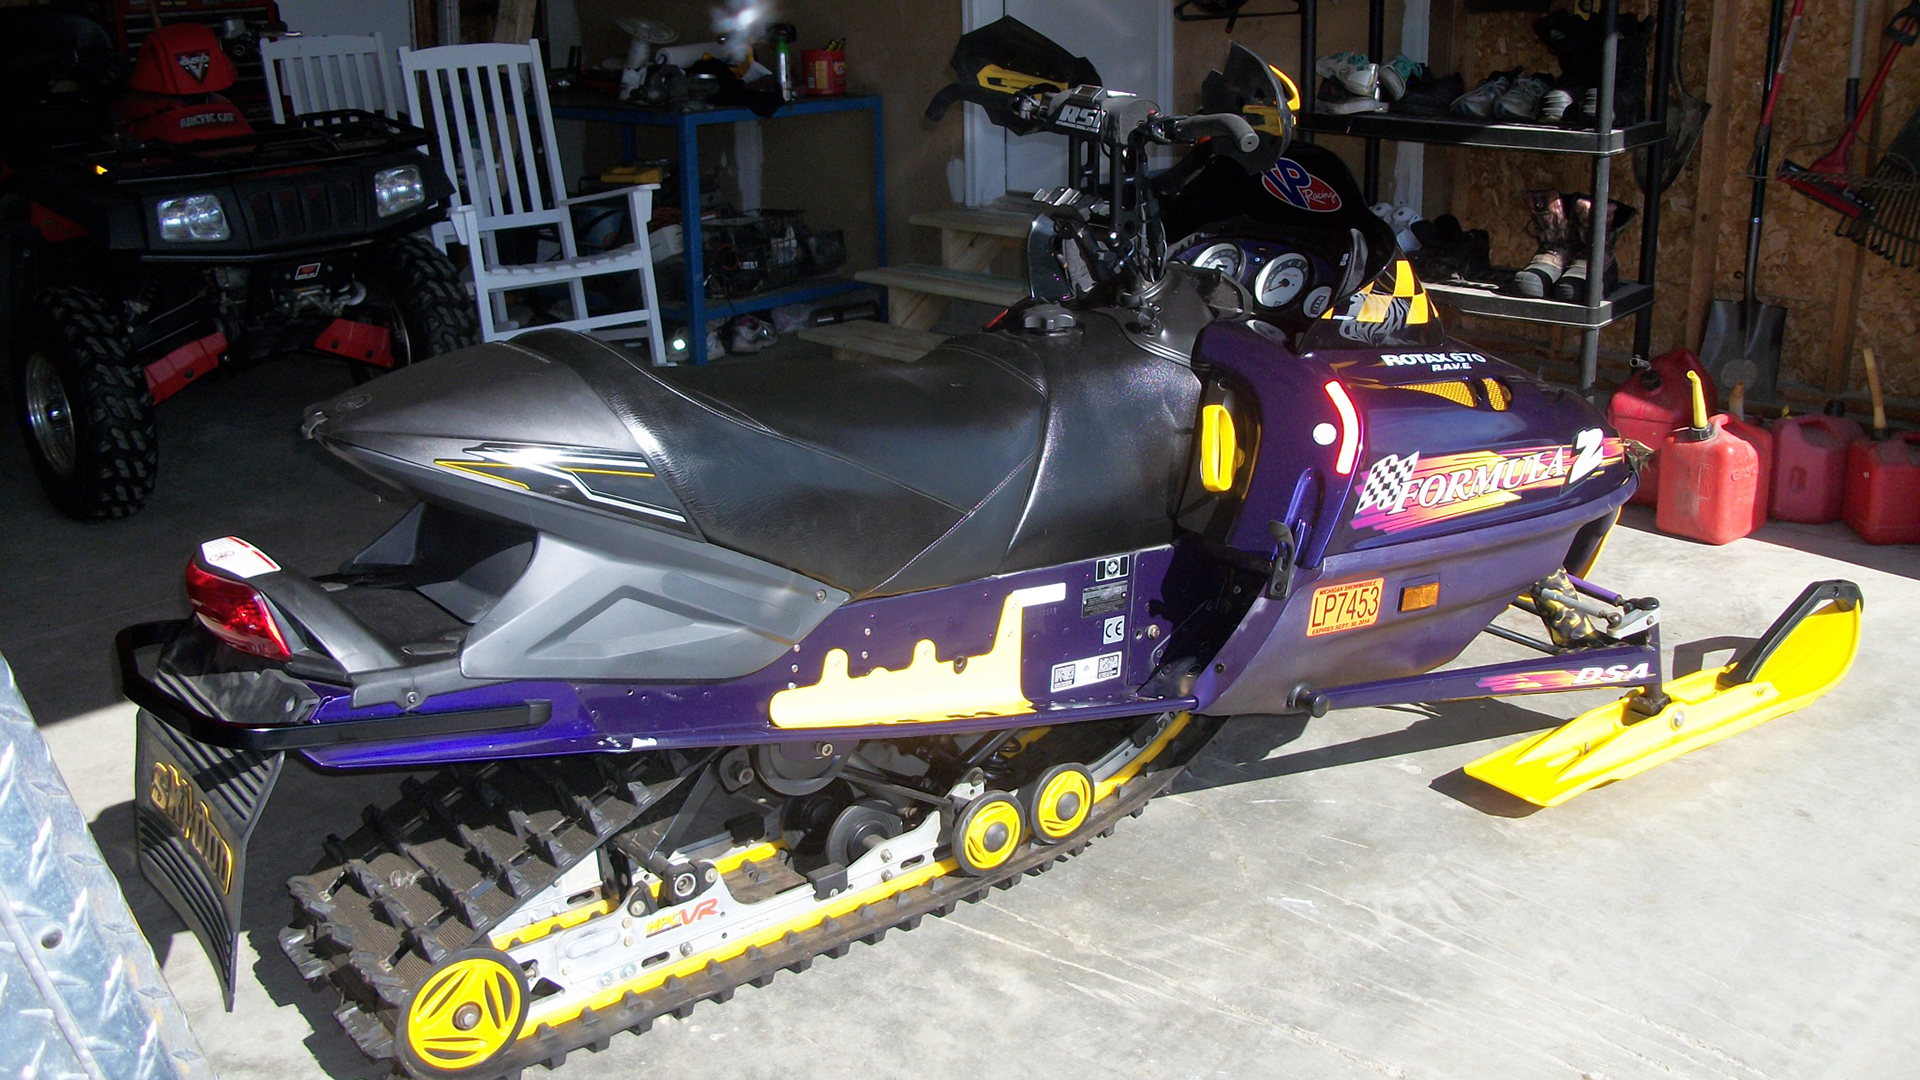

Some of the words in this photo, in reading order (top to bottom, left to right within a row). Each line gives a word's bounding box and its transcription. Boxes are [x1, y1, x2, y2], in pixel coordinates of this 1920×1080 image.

[1260, 157, 1312, 210] VP
[1303, 188, 1337, 205] Racing
[1380, 354, 1450, 367] ROTAX
[1450, 352, 1487, 364] 670
[1386, 445, 1566, 516] FORMULA
[1319, 587, 1343, 596] MICHIGAN
[1345, 581, 1377, 591] SNOWMOBILE
[1312, 586, 1380, 627] LP7453
[1105, 620, 1123, 638] CE
[1312, 625, 1334, 635] EXPIRES
[1572, 663, 1650, 684] DSA
[151, 761, 234, 896] ski-doo
[681, 898, 719, 925] VR
